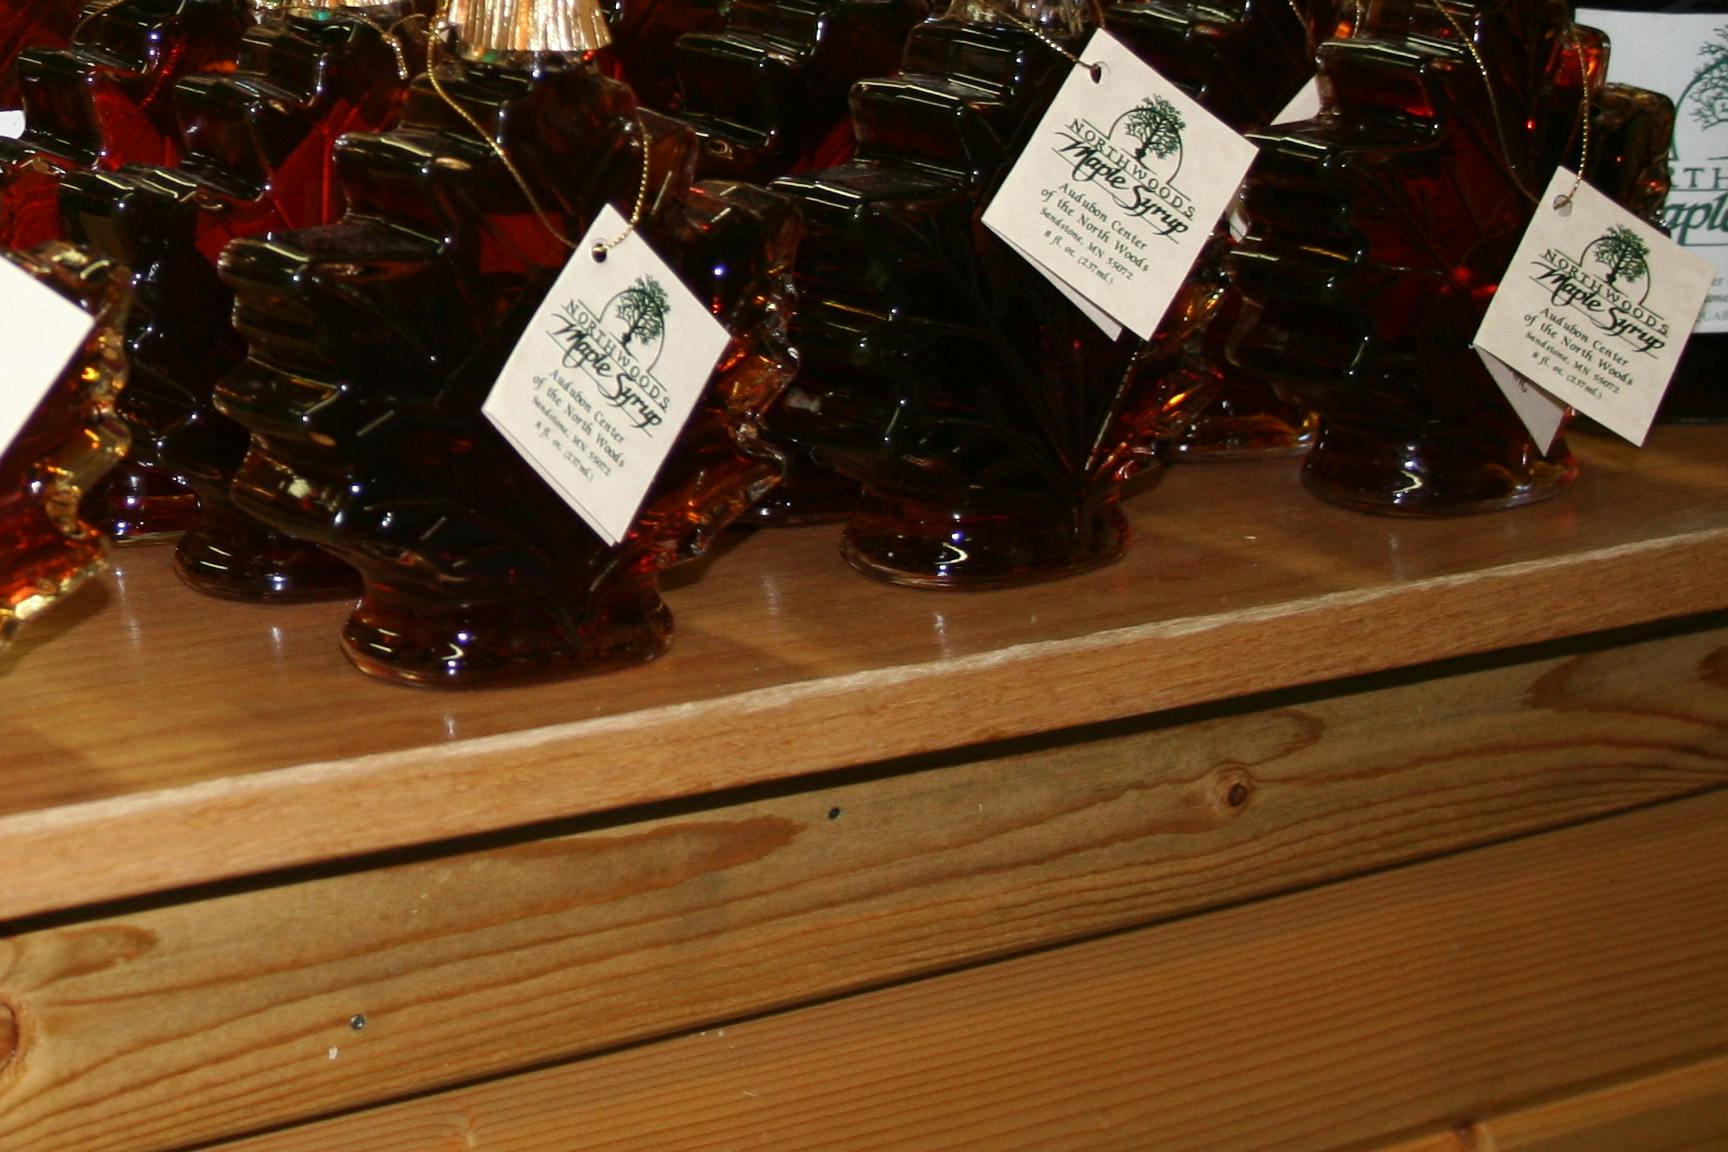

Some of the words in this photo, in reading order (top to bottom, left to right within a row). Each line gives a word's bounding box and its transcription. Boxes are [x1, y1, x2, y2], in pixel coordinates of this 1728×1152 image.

[1054, 132, 1129, 190] Maple
[1113, 185, 1189, 235] Syrup
[1069, 119, 1196, 219] NORTHWOODS
[1041, 189, 1058, 202] of
[1057, 199, 1075, 216] the
[1078, 214, 1110, 243] North
[1115, 240, 1150, 271] Woods
[1059, 183, 1108, 222] Audubon
[1111, 220, 1148, 250] Center
[1085, 242, 1105, 258] MN
[1106, 257, 1134, 280] 55072
[1543, 249, 1670, 336] NORTHWOODS
[1530, 261, 1606, 312] Maple
[1590, 307, 1665, 352] Syrup
[1541, 308, 1589, 342] Audubon
[1593, 340, 1629, 367] Center
[551, 313, 612, 378] Maple
[596, 373, 662, 428] Syrup
[565, 299, 670, 412] NORTHWOODS
[1524, 314, 1539, 326] of
[1540, 323, 1557, 339] the
[1560, 336, 1593, 362] North
[1598, 359, 1634, 386] Woods
[1573, 361, 1590, 375] MN
[532, 376, 546, 389] of
[546, 387, 562, 406] the
[564, 405, 592, 436] North
[596, 433, 625, 468] Woods
[549, 369, 592, 412] Audubon
[594, 411, 624, 444] Center
